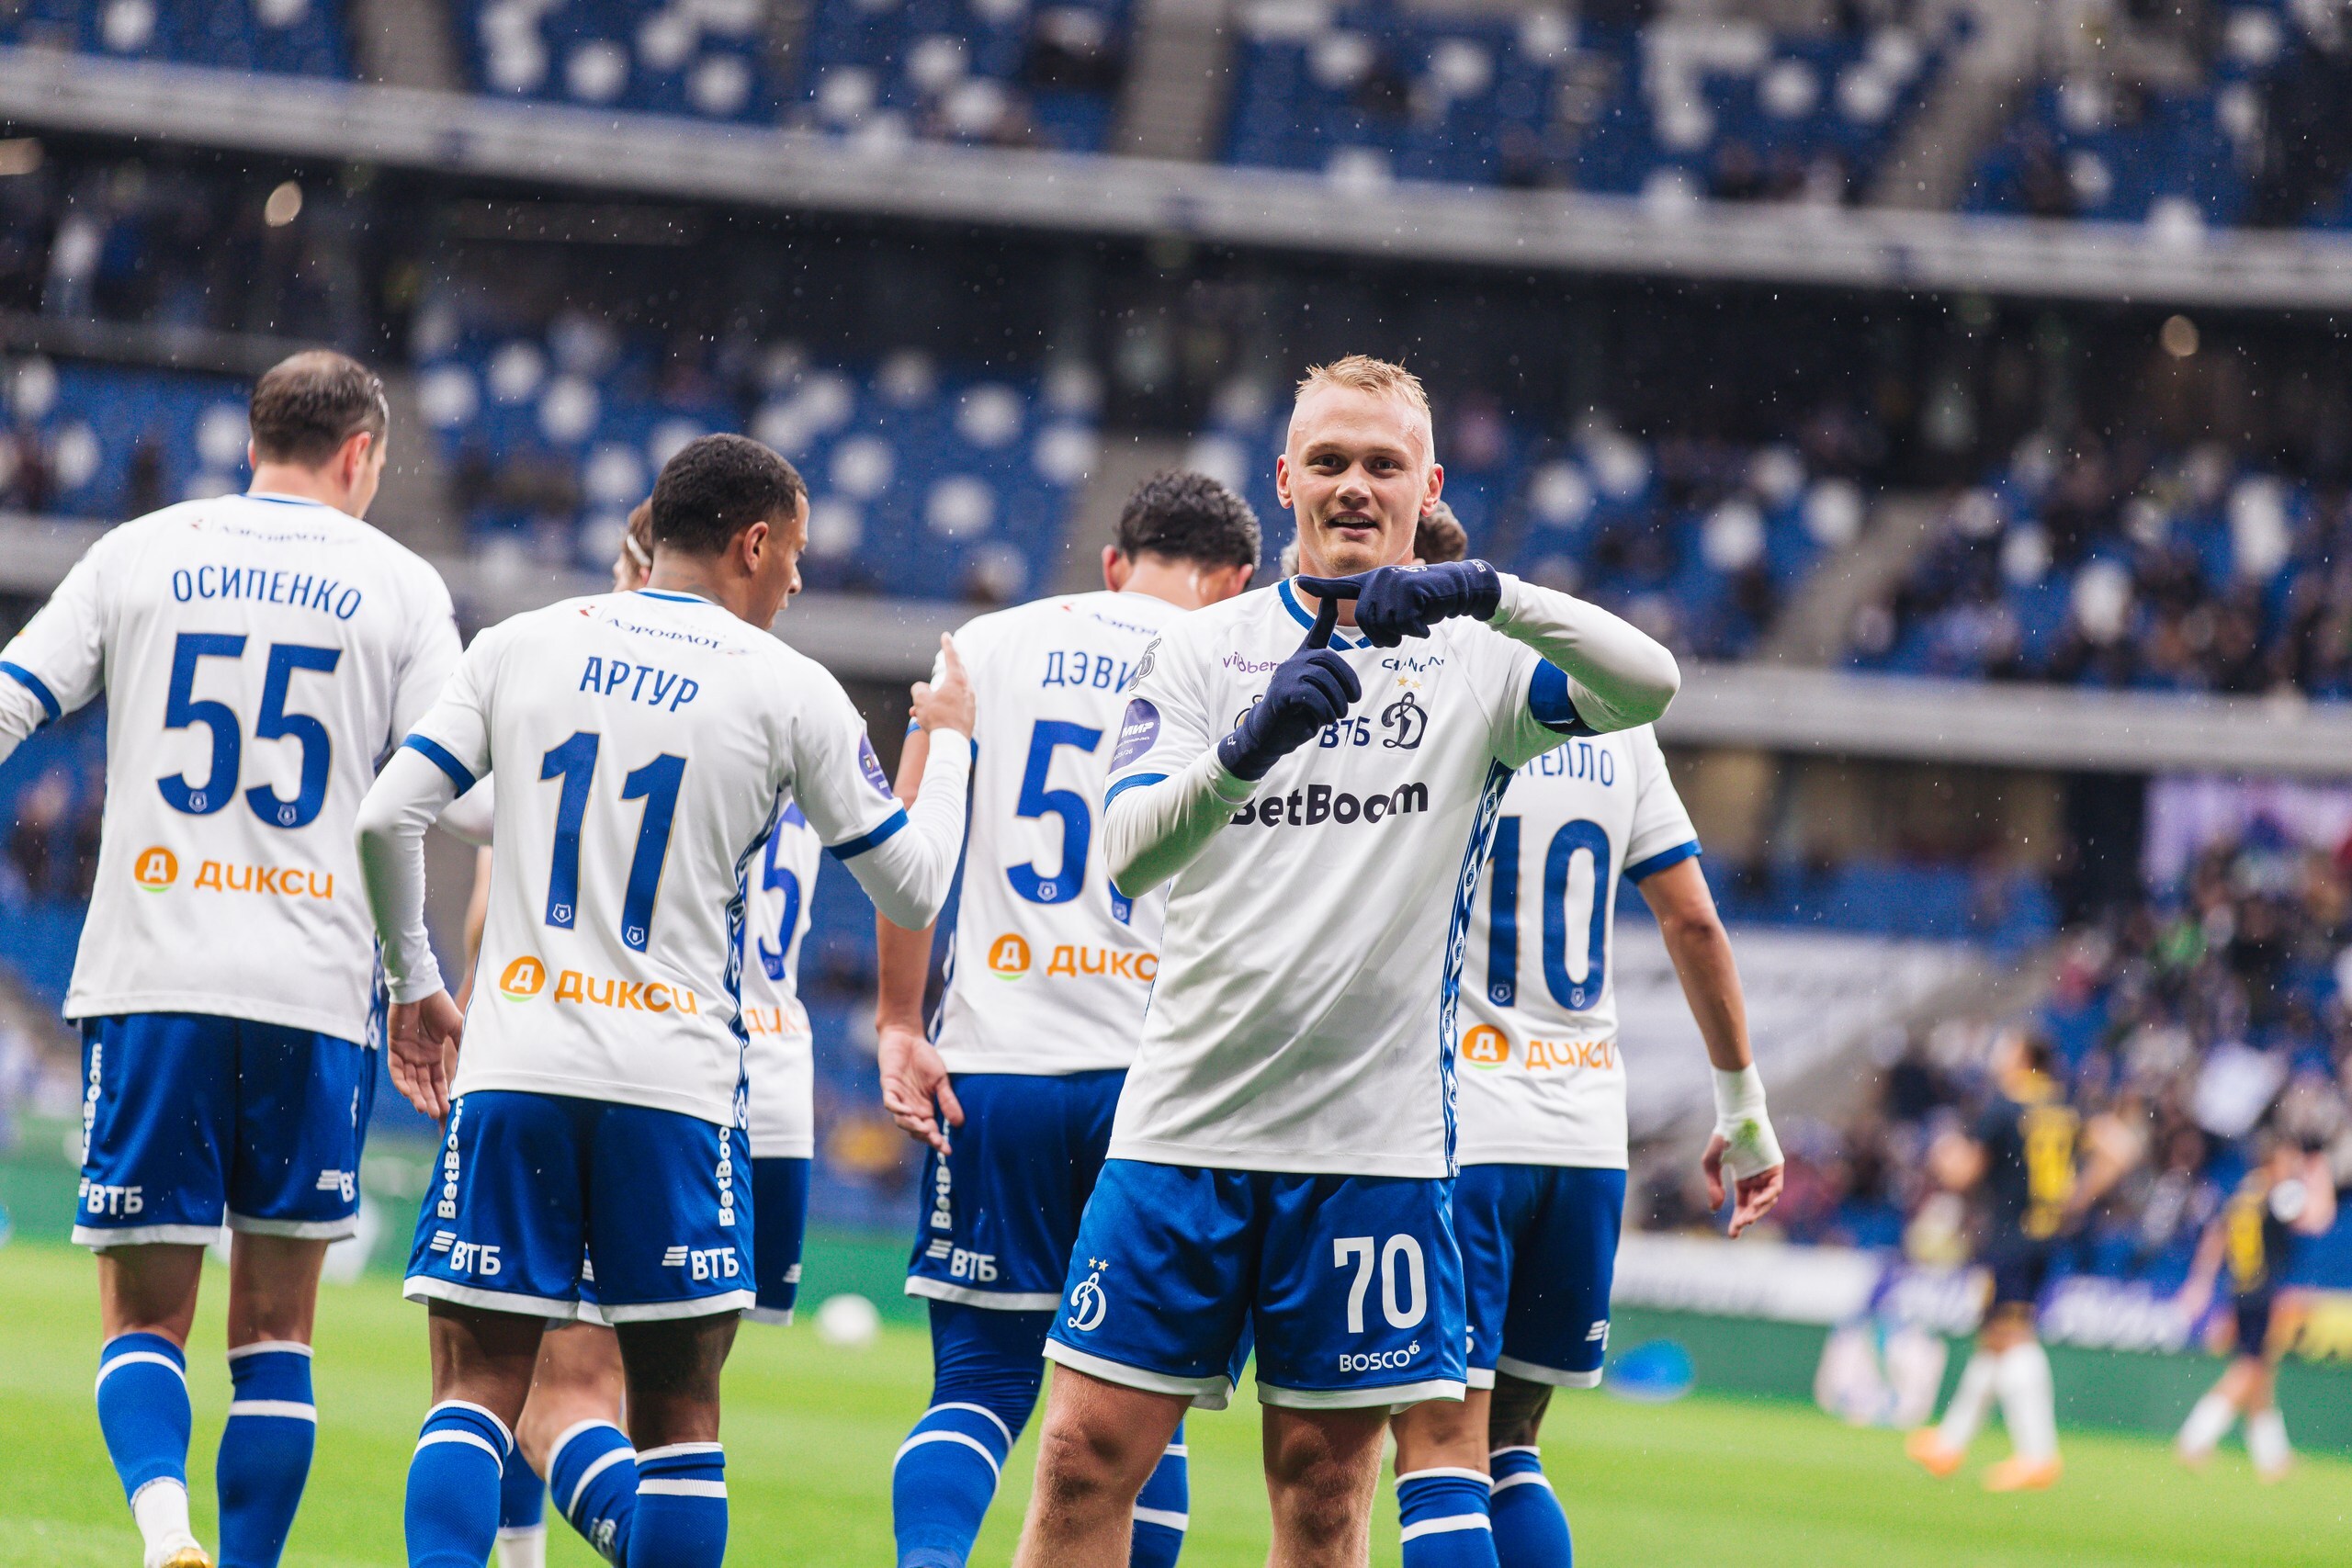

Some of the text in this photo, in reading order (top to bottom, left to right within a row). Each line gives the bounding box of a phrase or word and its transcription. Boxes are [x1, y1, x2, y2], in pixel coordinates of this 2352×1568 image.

[173, 565, 362, 621] ОСИПЕНКО
[606, 617, 723, 649] АЭРОФЛОТ
[579, 656, 699, 712] АРТУР
[1042, 650, 1140, 694] ДЭВИ
[157, 632, 344, 828] 55
[537, 730, 689, 953] 11
[1006, 719, 1136, 926] 5
[735, 801, 807, 980] 5
[1486, 815, 1611, 1011] 10
[1046, 945, 1159, 982] дикс
[87, 1183, 143, 1215] ВТБ
[716, 1126, 735, 1227] BetBoo
[450, 1241, 501, 1276] ВТБ
[691, 1247, 739, 1280] ВТБ
[950, 1247, 999, 1282] ВТБ
[1333, 1234, 1427, 1333] 70
[1340, 1348, 1410, 1372] BOSCO
